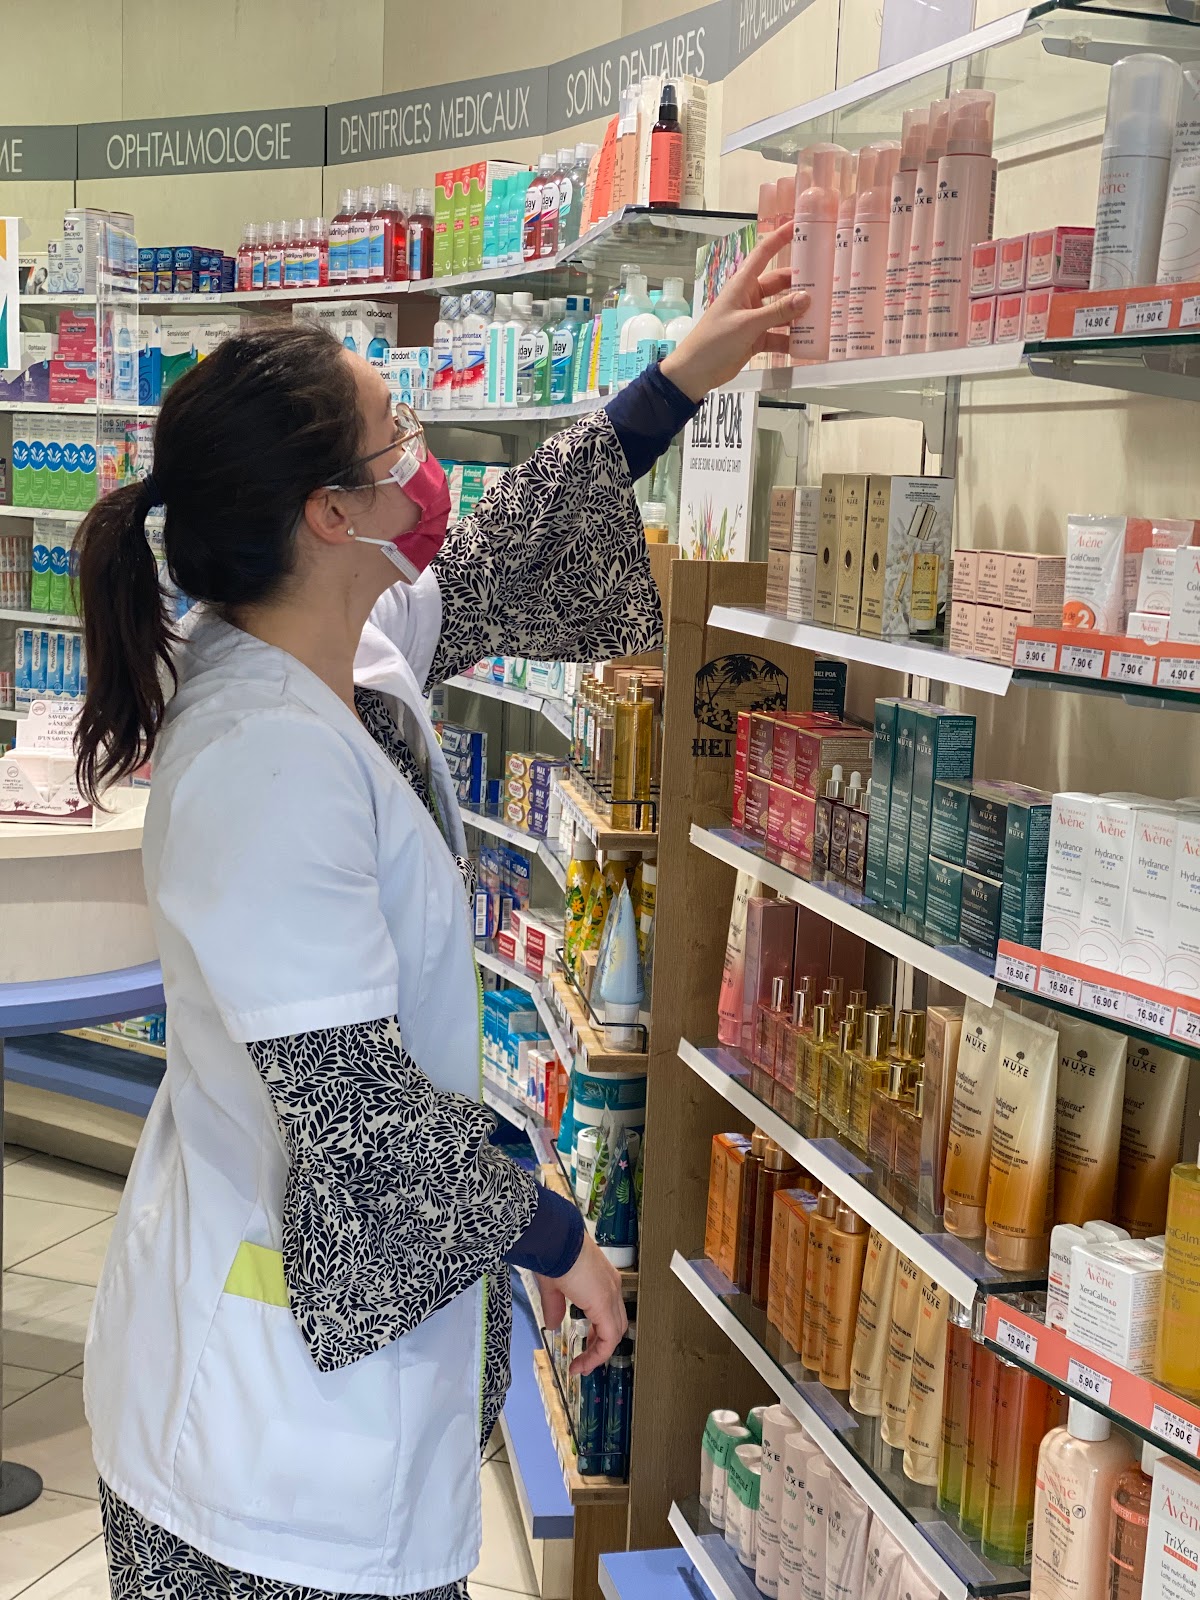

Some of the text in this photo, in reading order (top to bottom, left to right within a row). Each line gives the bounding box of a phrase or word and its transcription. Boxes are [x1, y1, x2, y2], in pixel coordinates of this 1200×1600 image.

[566, 27, 706, 118] SOINS DENTAIRES
[340, 86, 530, 155] DENTIFRICES MEDICAUX
[106, 122, 291, 170] OPHTALMOLOGIE
[542, 196, 553, 207] day
[366, 309, 392, 319] alodont
[1136, 311, 1164, 323] 11.90 €
[1085, 316, 1111, 327] 14.90 €
[1076, 535, 1103, 548] Avène
[1071, 553, 1100, 563] Cold Cream
[1077, 610, 1090, 628] 2
[1026, 650, 1046, 662] 9.90 €
[1071, 658, 1092, 669] 7.90 €
[1120, 663, 1143, 675] 7.90 €
[1170, 669, 1195, 681] 4.90 €
[875, 732, 890, 742] NUXE
[898, 737, 913, 748] NUXE
[692, 738, 732, 758] HEI
[917, 743, 932, 755] NUXE
[942, 798, 958, 809] NUXE
[980, 810, 997, 823] NUXE
[1056, 812, 1085, 830] Avène
[1008, 828, 1024, 839] NUXE
[1097, 820, 1127, 838] Avène
[1142, 829, 1173, 847] Avène
[1055, 840, 1083, 853] Hydrance
[1095, 848, 1123, 862] Hydrance
[1138, 857, 1170, 871] Hydrance
[936, 874, 951, 886] NUXE
[1091, 877, 1120, 890] Crème hydratante
[971, 888, 988, 902] NUXE
[1148, 891, 1167, 901] hydratante
[1177, 901, 1189, 910] Crème
[1006, 966, 1023, 980] 18.50
[1024, 973, 1030, 982] €
[1049, 980, 1074, 996] 18.50 €
[1093, 995, 1118, 1010] 16.90 €
[1137, 1008, 1165, 1025] 16.90 €
[966, 1034, 987, 1053] NUXE
[1002, 1058, 1029, 1078] NUXE
[1061, 1057, 1096, 1077] NUXE
[869, 1232, 883, 1251] NUXE
[899, 1259, 917, 1280] NUXE
[1085, 1267, 1113, 1289] Avène
[922, 1289, 940, 1310] NUXE
[1080, 1284, 1108, 1303] XeraCalm
[1007, 1333, 1031, 1354] 19.90 €
[1079, 1374, 1099, 1392] 5.90 €
[1164, 1421, 1192, 1444] 17.90 €
[1161, 1484, 1175, 1496] EAU
[1162, 1494, 1200, 1532] Avèn
[1164, 1530, 1199, 1563] TriXera
[1161, 1560, 1170, 1570] Lait
